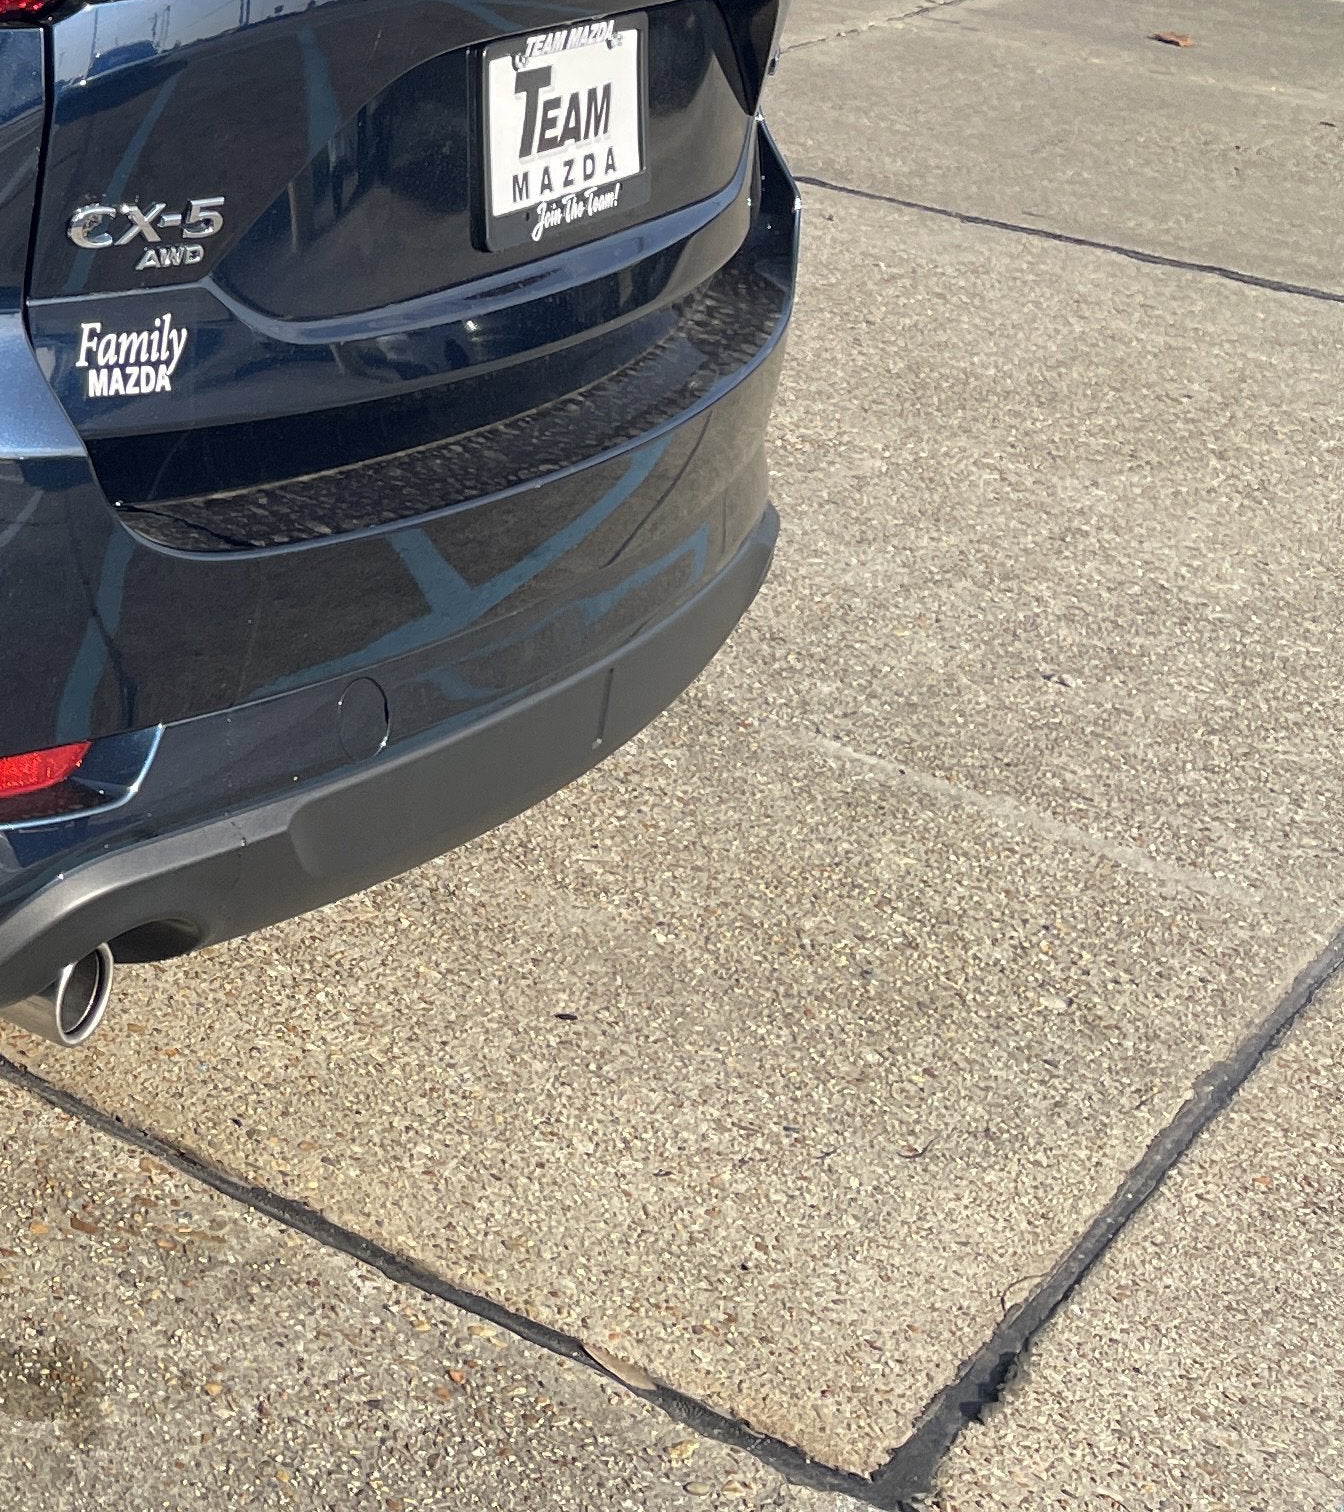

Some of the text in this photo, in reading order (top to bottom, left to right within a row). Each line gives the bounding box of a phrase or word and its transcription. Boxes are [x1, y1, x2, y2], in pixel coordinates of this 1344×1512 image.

[524, 19, 616, 58] TEAM MAZDA
[512, 146, 617, 203] MAZDA
[67, 196, 225, 249] CX-5
[531, 182, 621, 241] Join The Team!
[135, 243, 205, 271] AWD
[75, 312, 188, 376] Family
[88, 364, 172, 398] MAZDA
